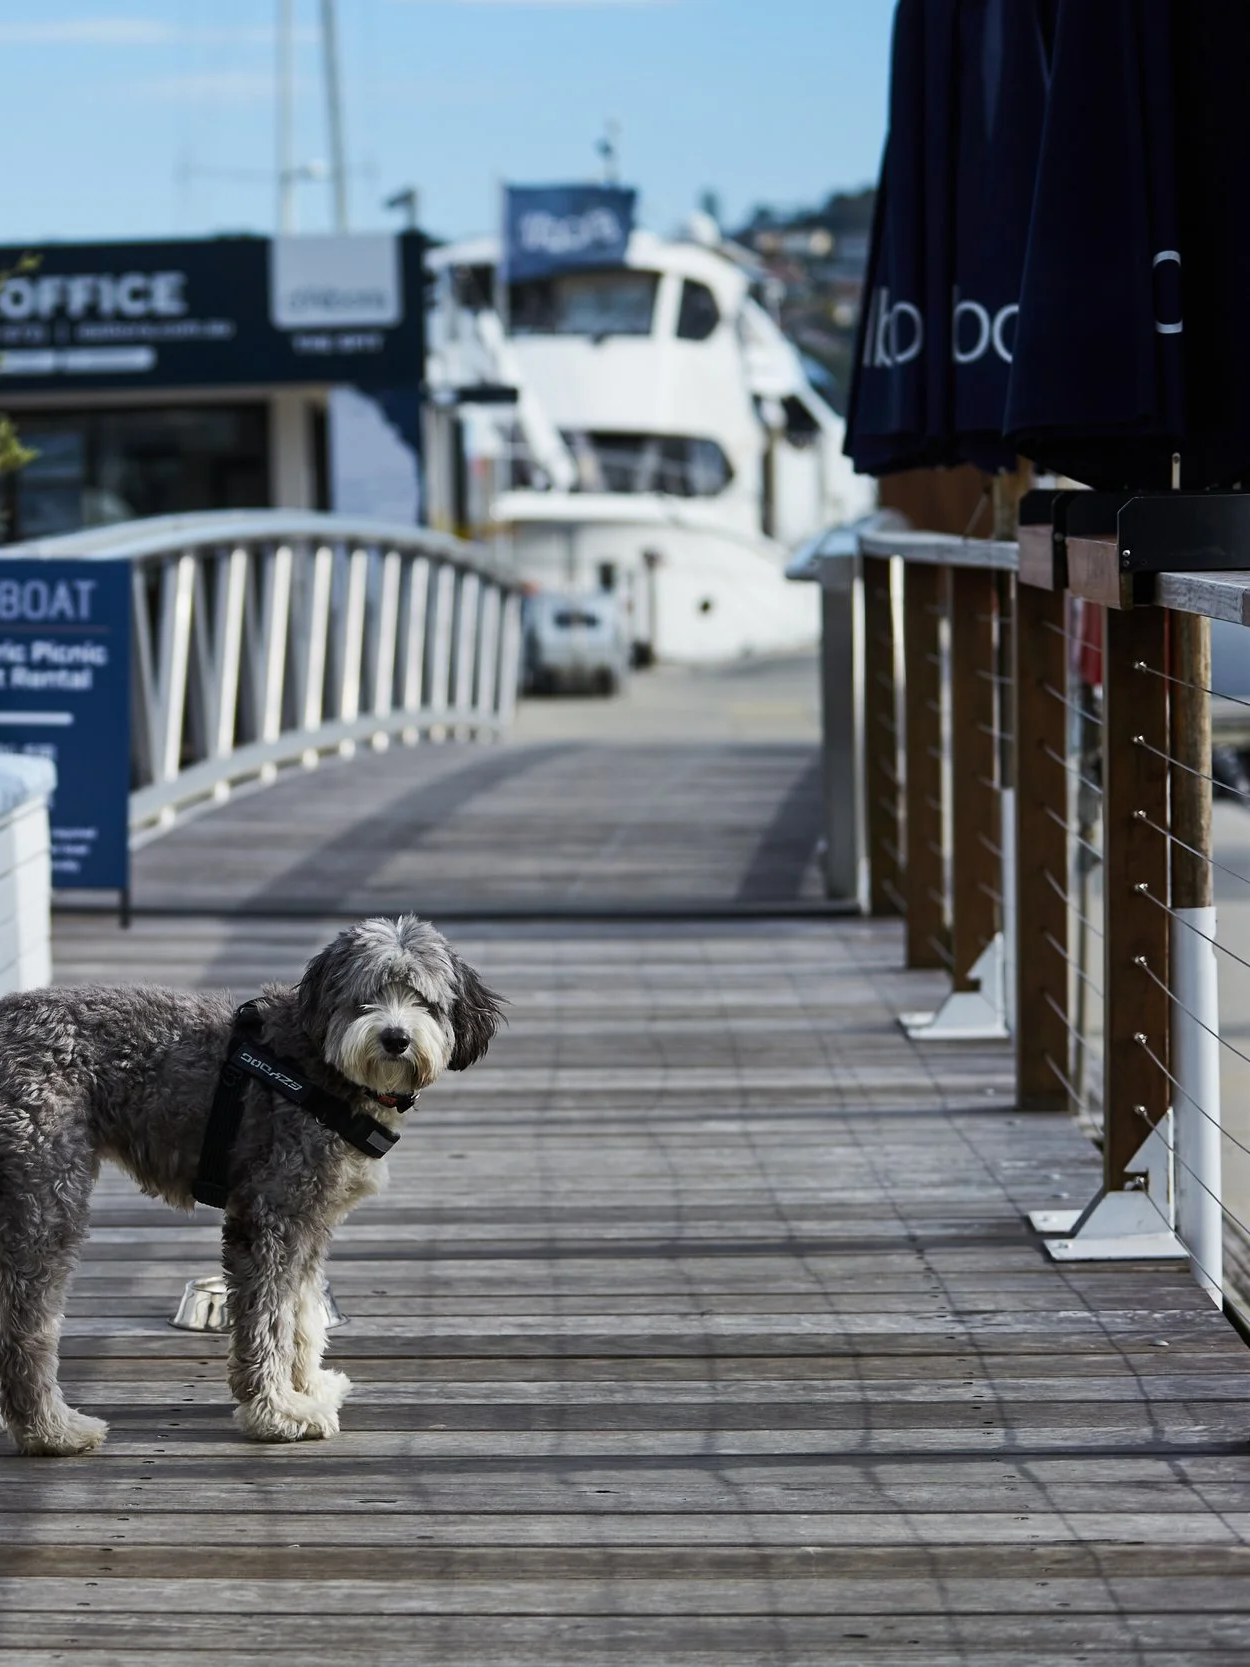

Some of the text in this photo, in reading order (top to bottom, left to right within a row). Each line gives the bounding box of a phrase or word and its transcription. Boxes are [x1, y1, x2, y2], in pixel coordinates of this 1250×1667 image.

[30, 638, 107, 666] Picnic
[11, 666, 93, 690] Rental
[240, 1052, 303, 1091] EZYDOG
